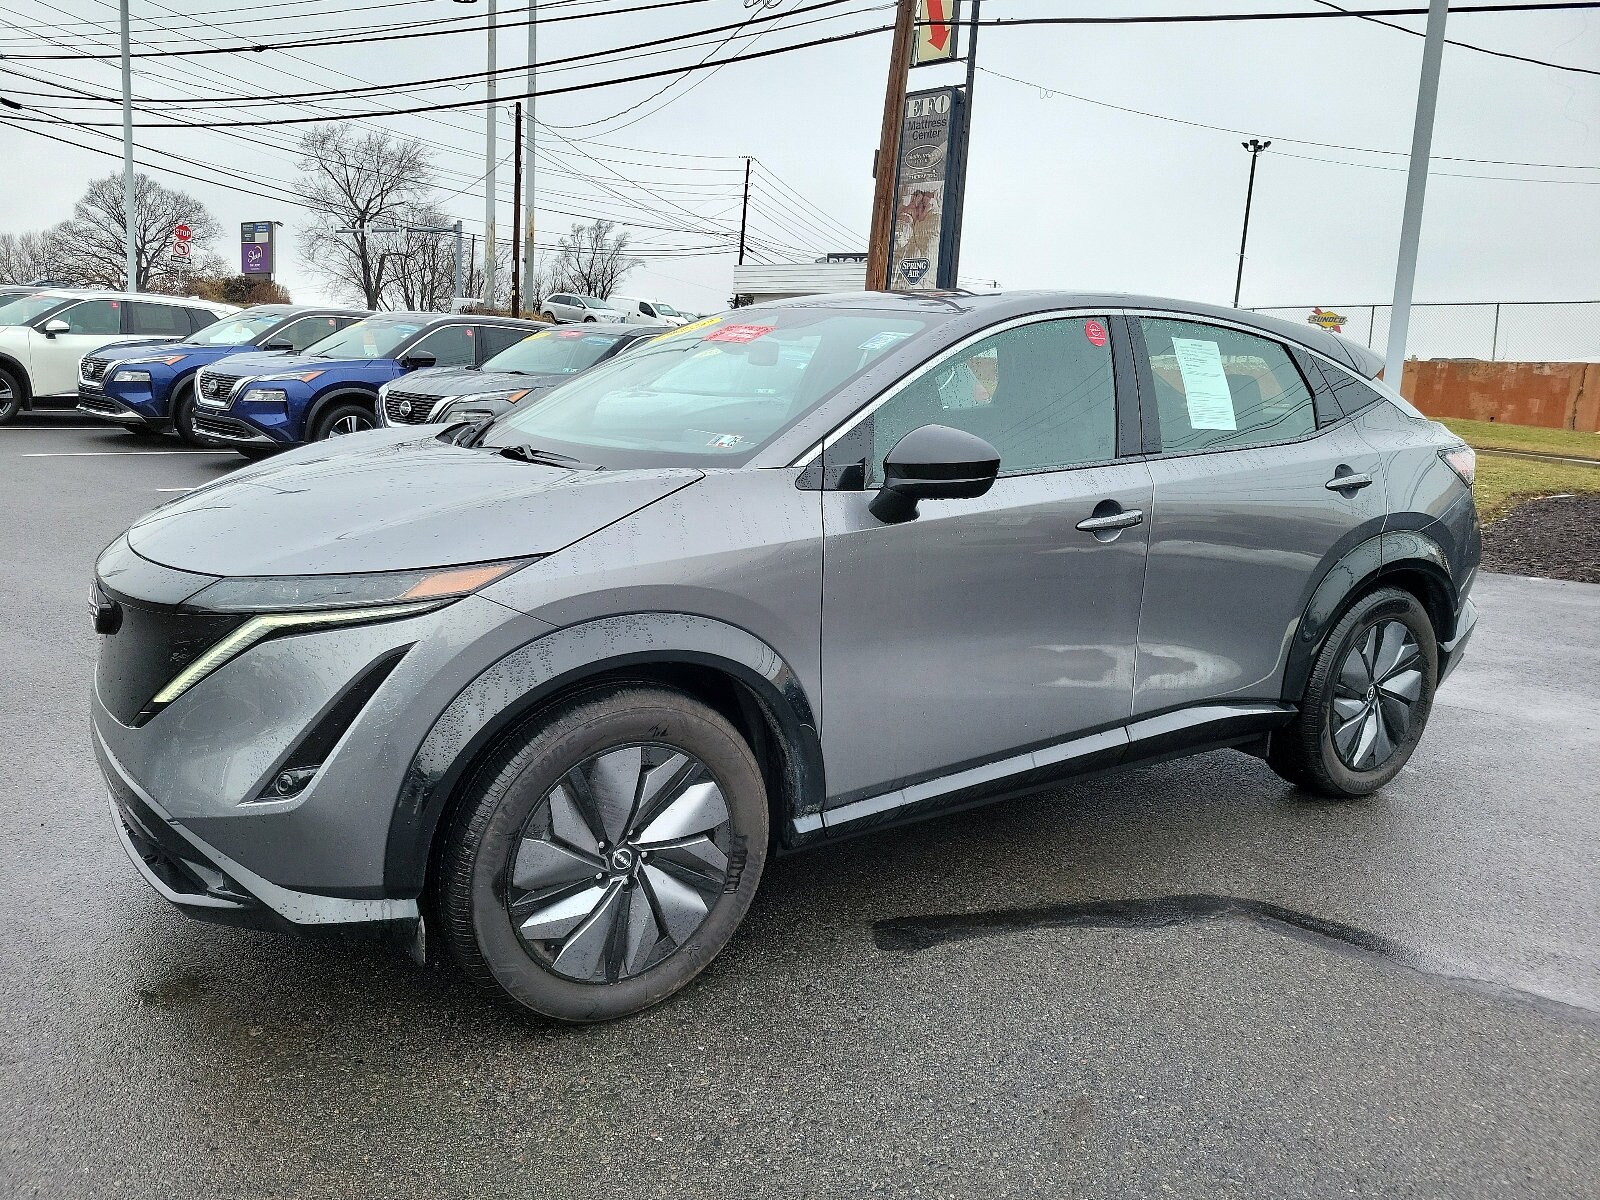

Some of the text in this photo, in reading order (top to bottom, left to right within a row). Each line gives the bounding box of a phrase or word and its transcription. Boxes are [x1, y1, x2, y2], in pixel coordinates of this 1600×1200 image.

[906, 94, 950, 119] EFO
[908, 118, 948, 131] Mattress
[912, 129, 942, 141] Center
[174, 228, 191, 237] STOP
[902, 261, 927, 270] SPRING
[907, 270, 920, 278] AIR
[1311, 315, 1346, 324] SUNOCO
